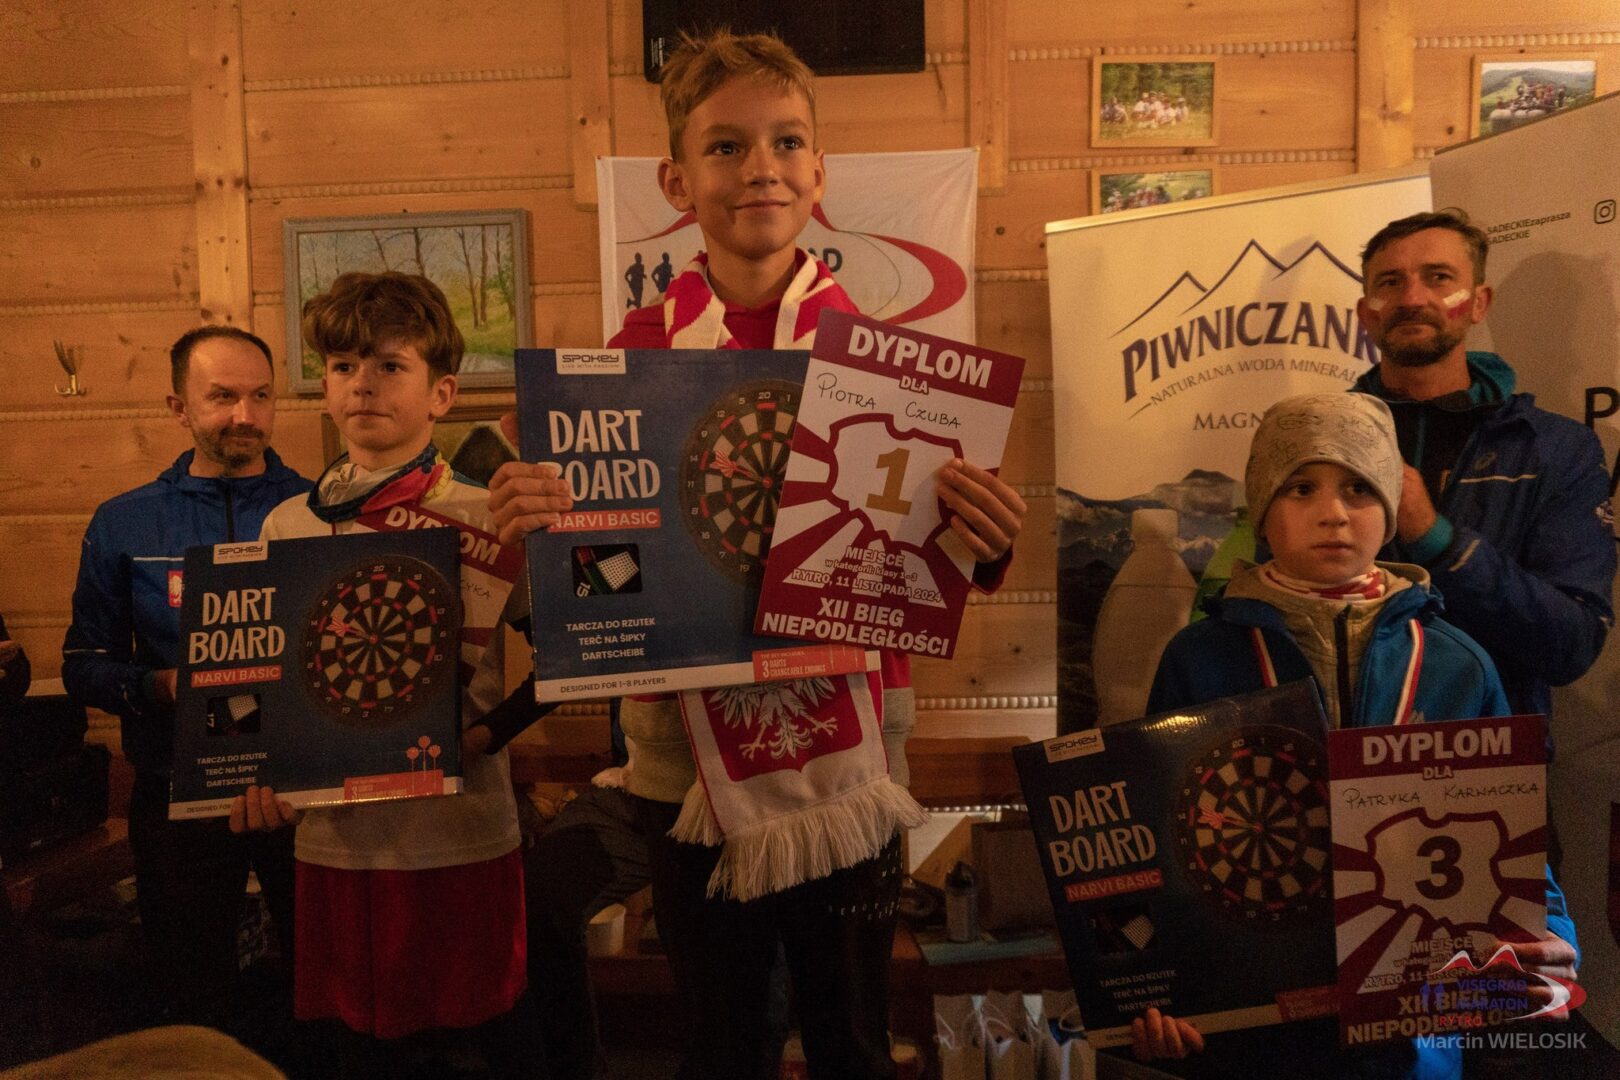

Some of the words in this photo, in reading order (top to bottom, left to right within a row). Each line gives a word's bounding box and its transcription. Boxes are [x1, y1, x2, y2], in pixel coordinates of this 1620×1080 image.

[847, 324, 993, 389] DYPLOM
[900, 375, 929, 395] DLA
[1151, 364, 1234, 406] NATURALNA
[1238, 358, 1286, 373] WODA
[905, 401, 962, 429] CZUBA
[549, 409, 642, 454] DART
[866, 447, 913, 515] 1
[607, 511, 658, 526] BASIC
[385, 505, 502, 566] DYPOM
[845, 545, 905, 568] MIEJSCE
[791, 568, 833, 588] RYTRO,
[835, 575, 850, 588] 11
[852, 578, 912, 598] LISTOPADA
[913, 588, 943, 603] 2024
[202, 586, 277, 626] DART
[817, 596, 850, 619] XII
[853, 602, 905, 628] BIEG
[566, 620, 604, 632] TARCZA
[605, 619, 620, 629] DO
[622, 617, 656, 628] RZUTEK
[604, 634, 619, 644] NA
[620, 631, 646, 644] ŠIPKY
[761, 611, 950, 656] NIEPODLEGŁOŚCI
[188, 625, 286, 664] BOARD
[582, 647, 645, 661] DARTSCHEIBE
[194, 669, 236, 685] NARVI
[239, 666, 280, 682] BASIC
[762, 659, 770, 678] 3
[561, 682, 600, 693] DESIGNED
[601, 680, 617, 690] FOR
[633, 676, 667, 686] PLAYERS
[197, 755, 226, 765] TARCZA
[227, 754, 239, 762] DO
[1362, 725, 1512, 767] DYPLOM
[1423, 765, 1453, 780] DLA
[1049, 779, 1132, 834] DART
[1342, 787, 1421, 810] PATRYKA
[1049, 823, 1158, 878] BOARD
[1415, 835, 1465, 900] 3
[1068, 881, 1113, 900] NARVI
[1115, 871, 1162, 892] BASIC
[1410, 935, 1473, 954] MIEJSCE
